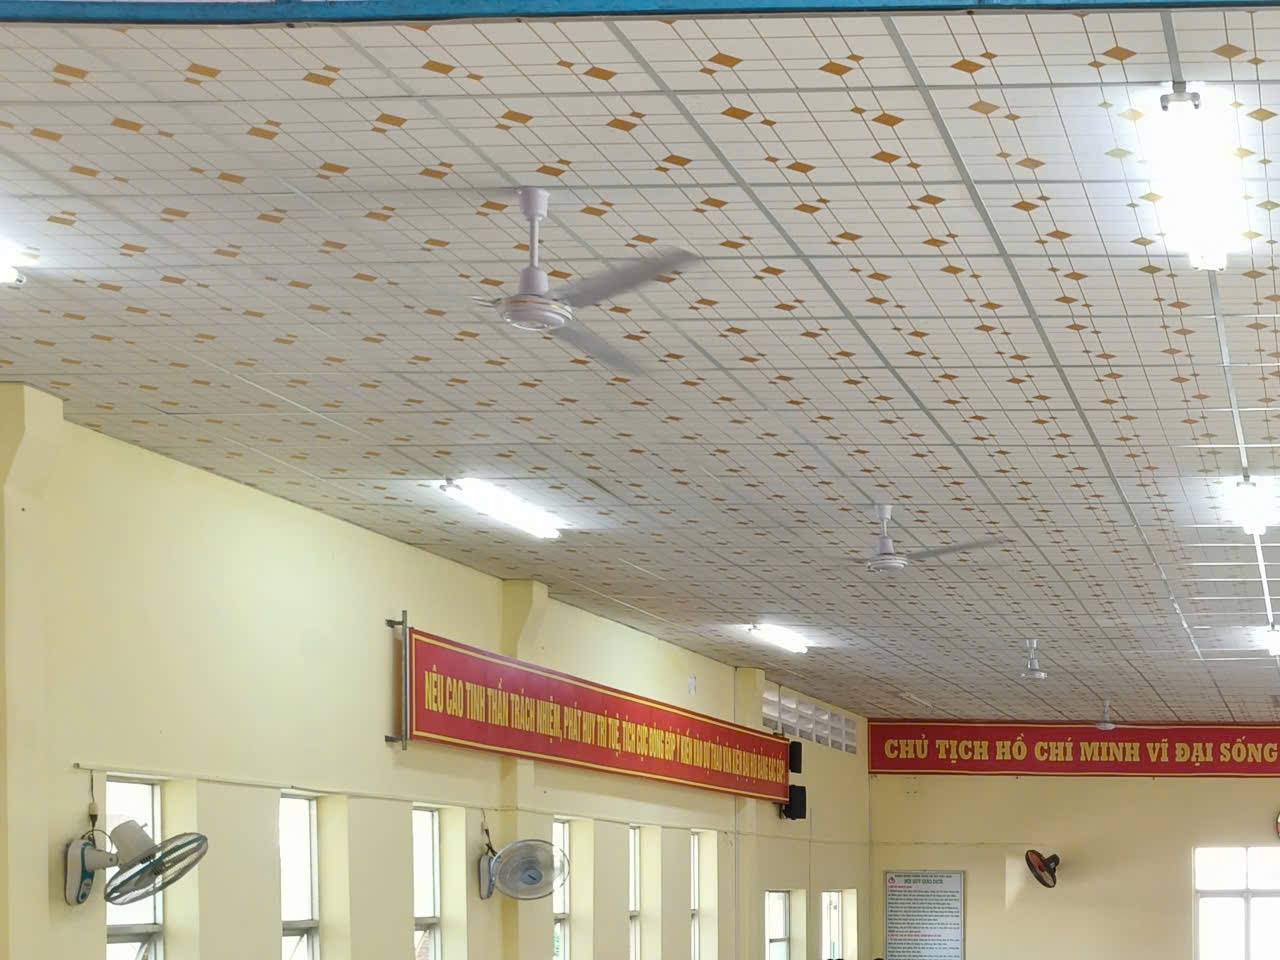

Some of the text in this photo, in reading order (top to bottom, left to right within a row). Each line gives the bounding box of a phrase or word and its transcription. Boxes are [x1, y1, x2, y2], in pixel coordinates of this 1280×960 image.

[425, 664, 443, 713] NÊU
[446, 676, 463, 717] CAO
[465, 681, 485, 722] TINH
[510, 687, 535, 732] TRÁCH
[536, 696, 562, 743] NHIỆM,
[563, 701, 580, 742] PHÁT
[582, 710, 596, 745] HUY
[596, 710, 607, 748] TRÍ
[622, 715, 635, 753] TÍCH
[884, 733, 929, 759] CHỦ
[936, 739, 989, 764] TỊCH
[995, 732, 1028, 761] HỒ
[1034, 736, 1073, 762] CHÍ
[1080, 741, 1140, 762] MINH
[1146, 738, 1169, 762] VĨ
[1175, 742, 1213, 766] ĐẠI
[1220, 735, 1278, 763] SỐNG
